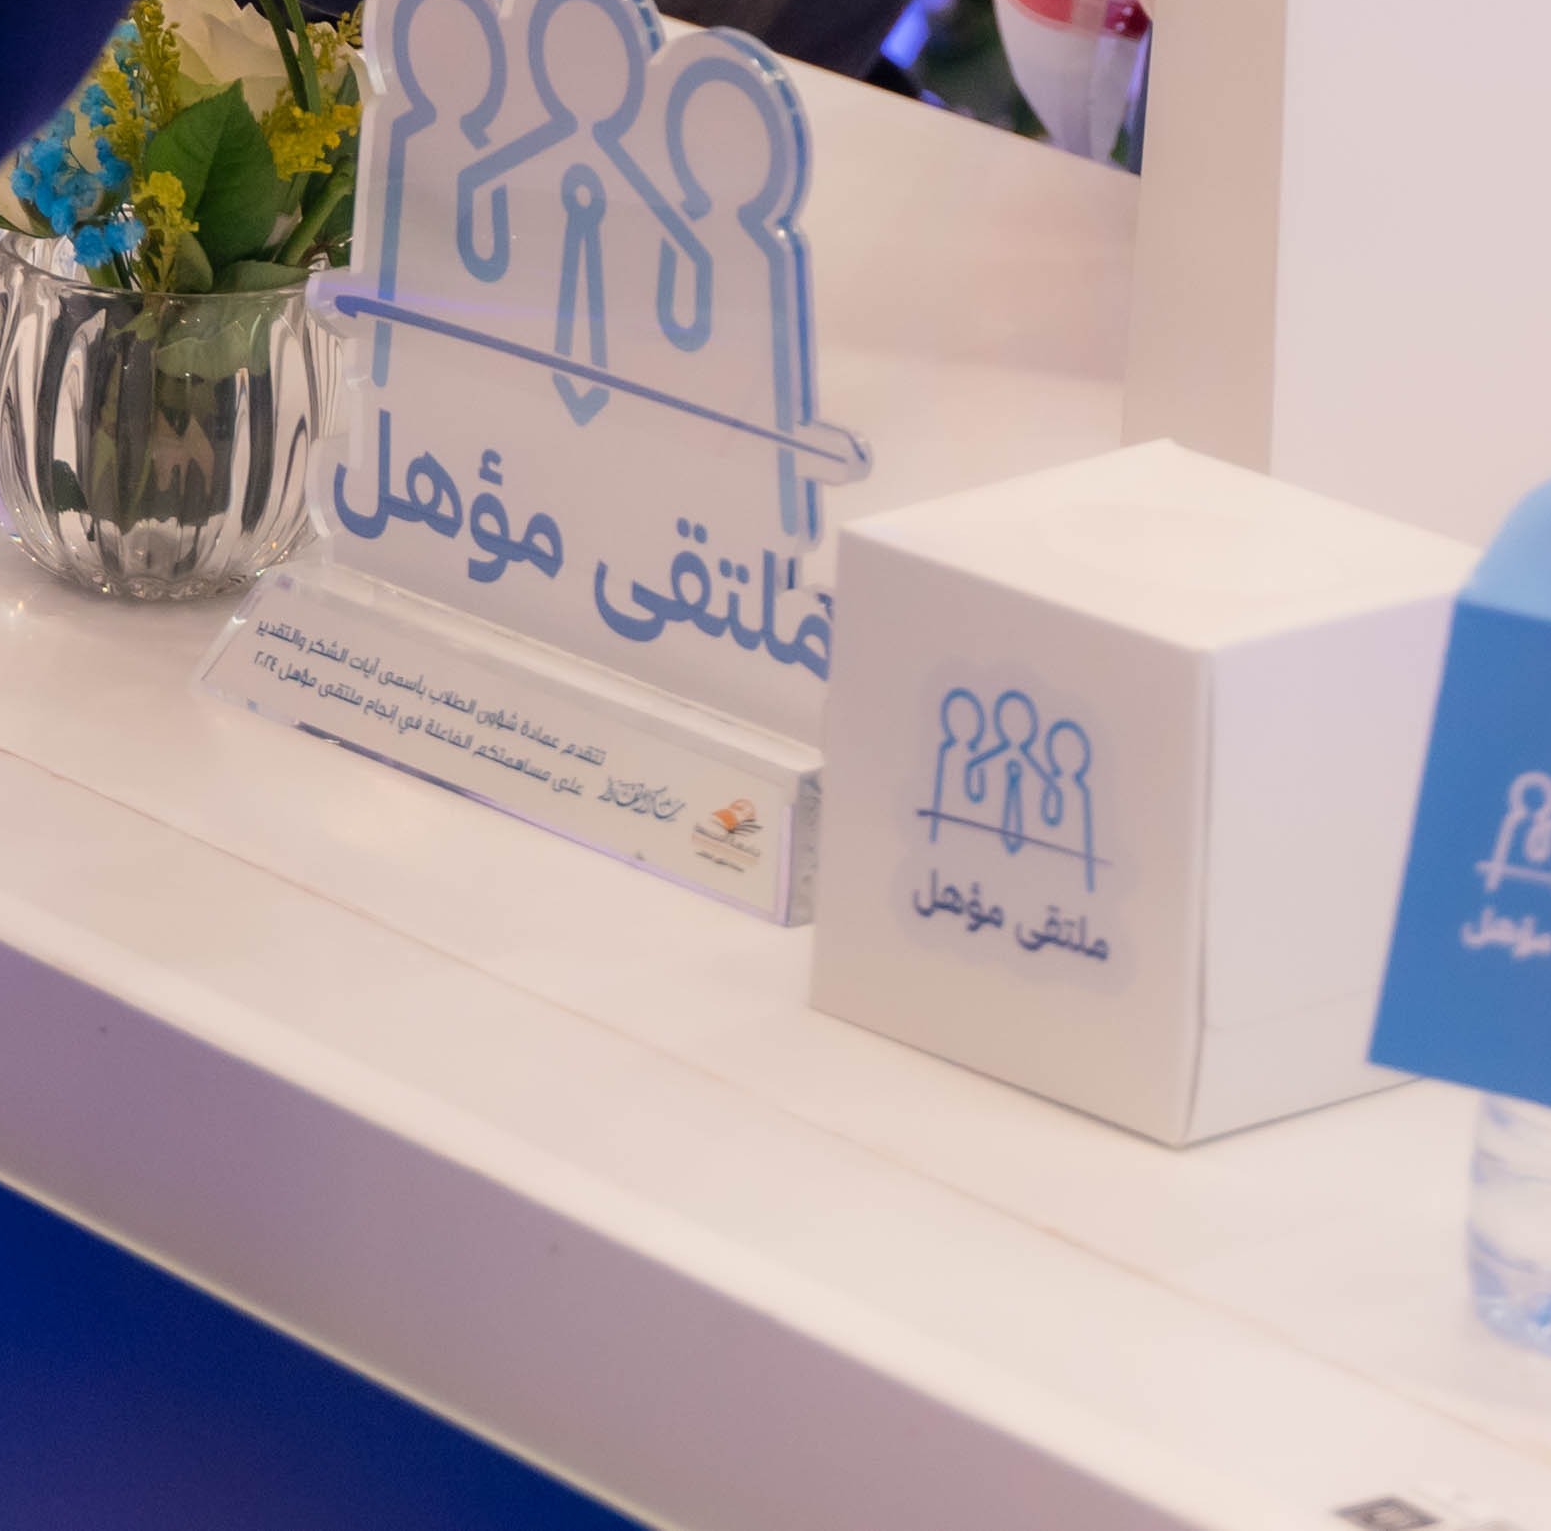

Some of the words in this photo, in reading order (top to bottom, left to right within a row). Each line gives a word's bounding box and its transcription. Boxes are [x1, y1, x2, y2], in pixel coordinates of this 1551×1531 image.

[333, 408, 564, 584] مؤهل
[594, 514, 834, 682] ملتقى
[306, 639, 350, 665] الشكر
[278, 662, 318, 688] مؤهل
[317, 682, 364, 707] ملتقى
[428, 689, 478, 715] الطلاب
[398, 715, 422, 735] في
[520, 720, 560, 749] عمادة
[551, 776, 585, 796] على
[912, 867, 1004, 933] مؤهل
[1014, 903, 1110, 962] ملتقى
